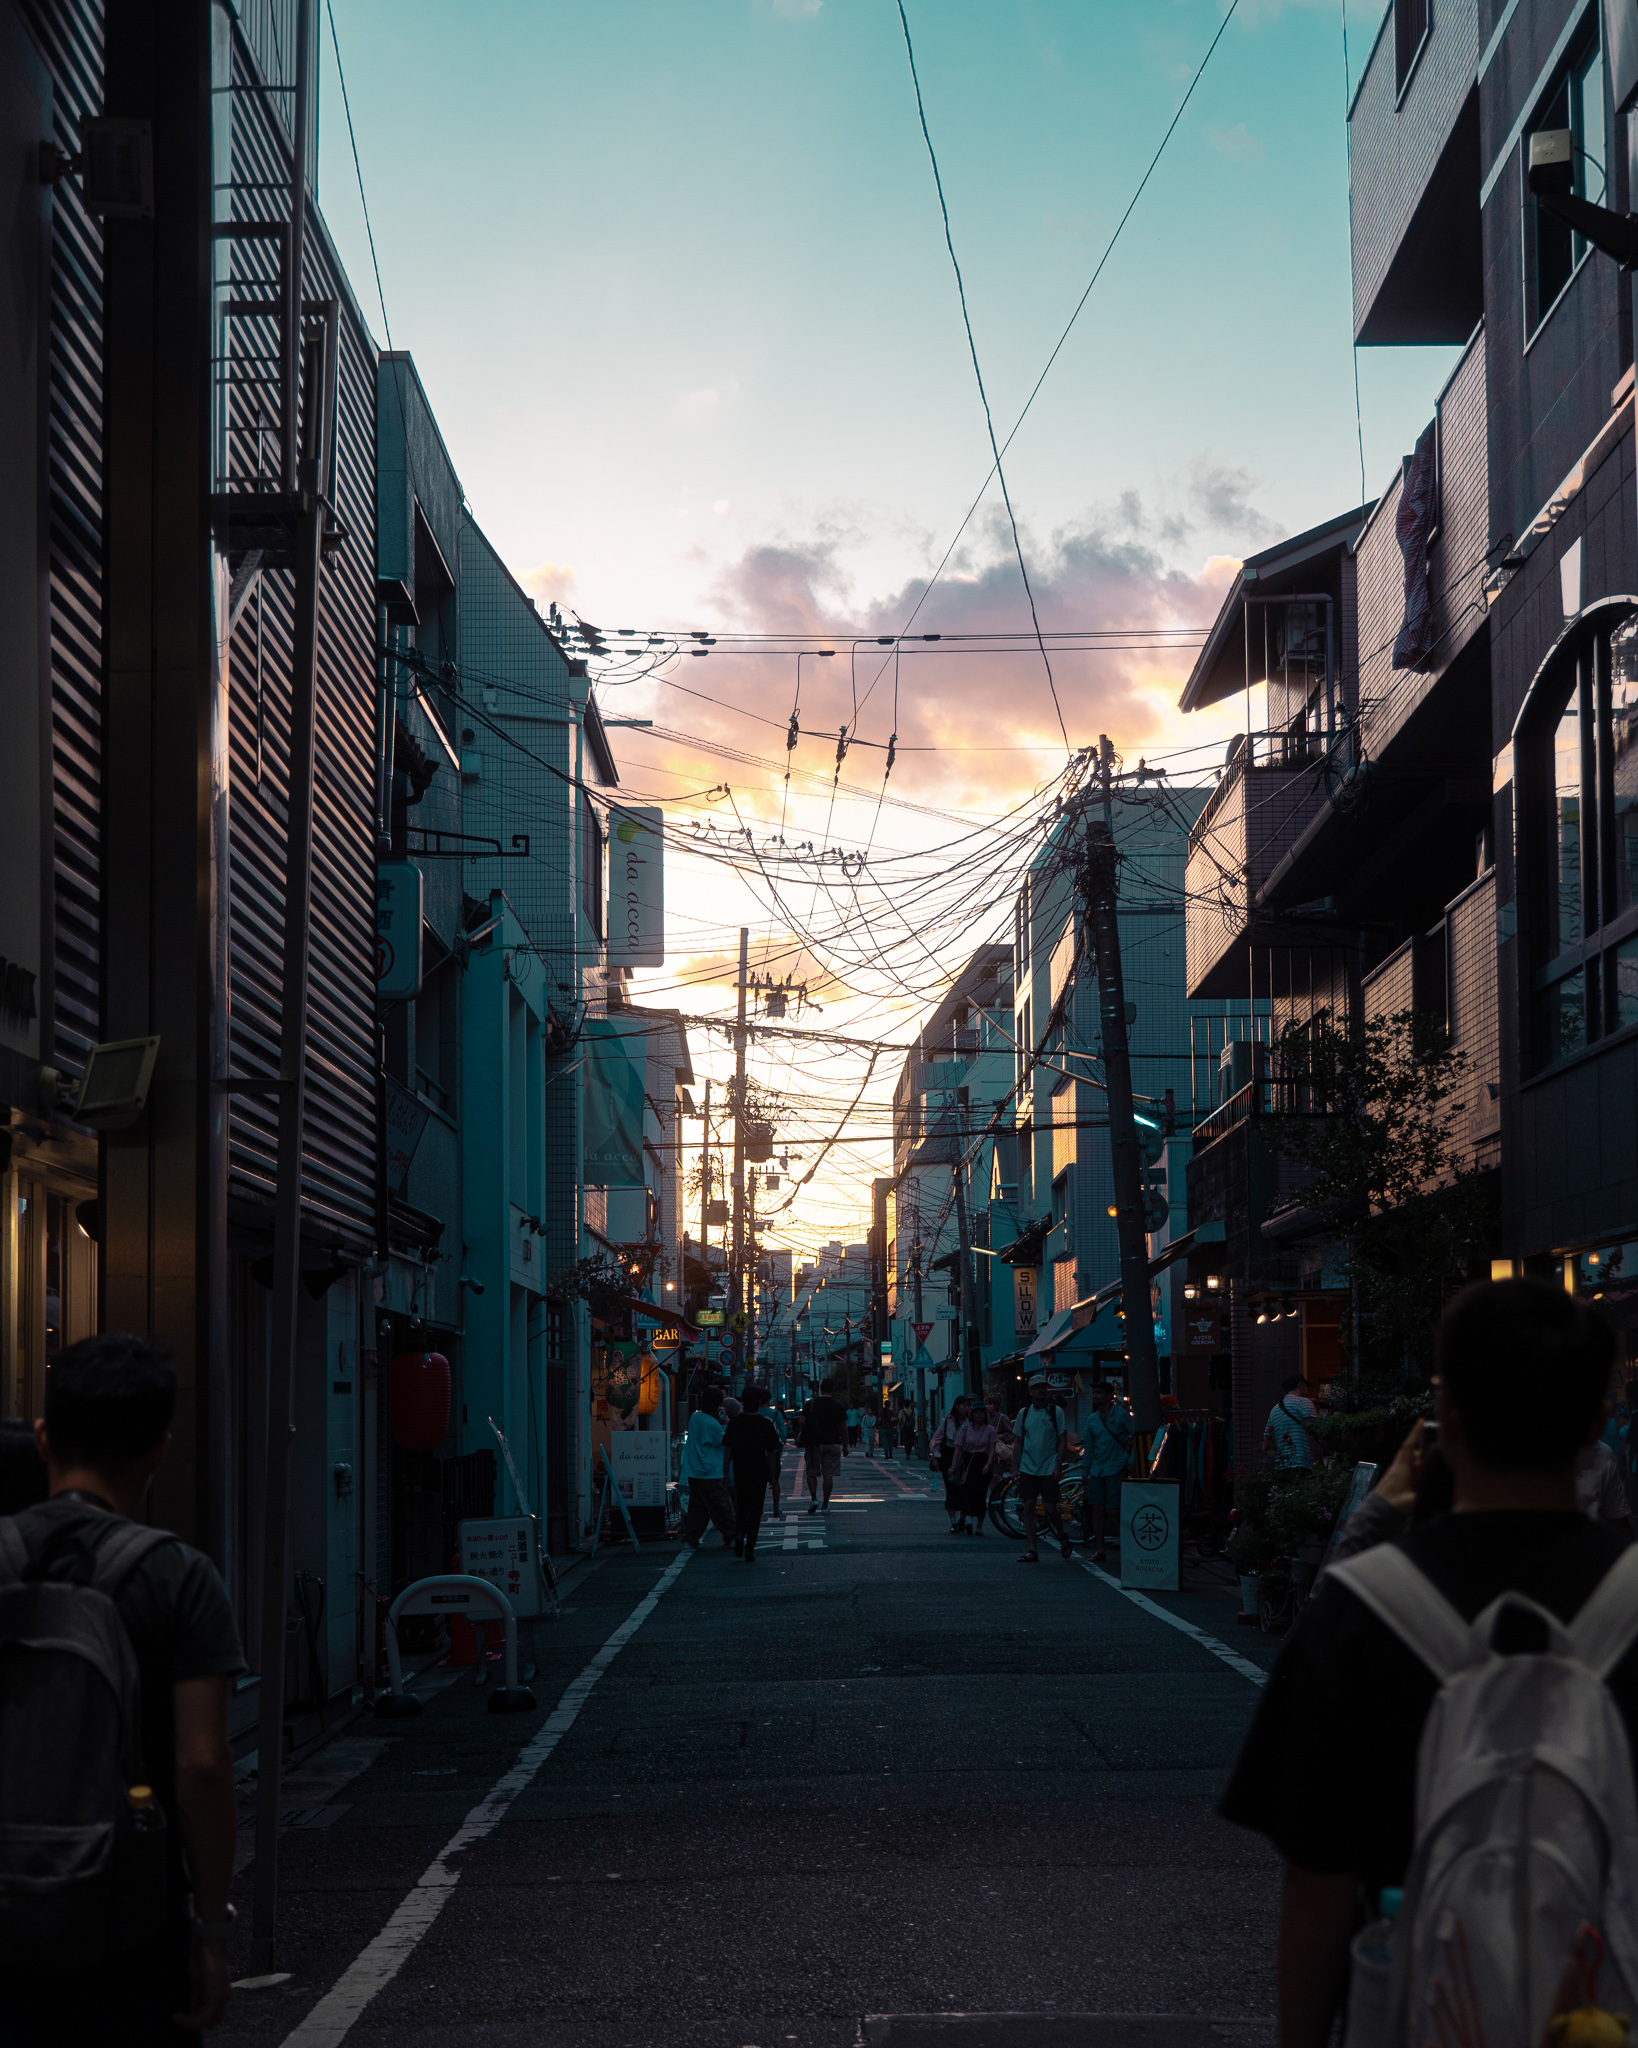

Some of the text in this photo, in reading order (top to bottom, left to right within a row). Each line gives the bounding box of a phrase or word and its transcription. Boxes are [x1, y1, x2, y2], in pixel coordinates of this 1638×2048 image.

[626, 851, 647, 953] da acca
[655, 1329, 679, 1341] BAR
[1048, 1374, 1070, 1385] たばこ
[619, 1451, 632, 1460] da
[1137, 1512, 1163, 1544] 茶
[1135, 1565, 1164, 1573] GOENCHA
